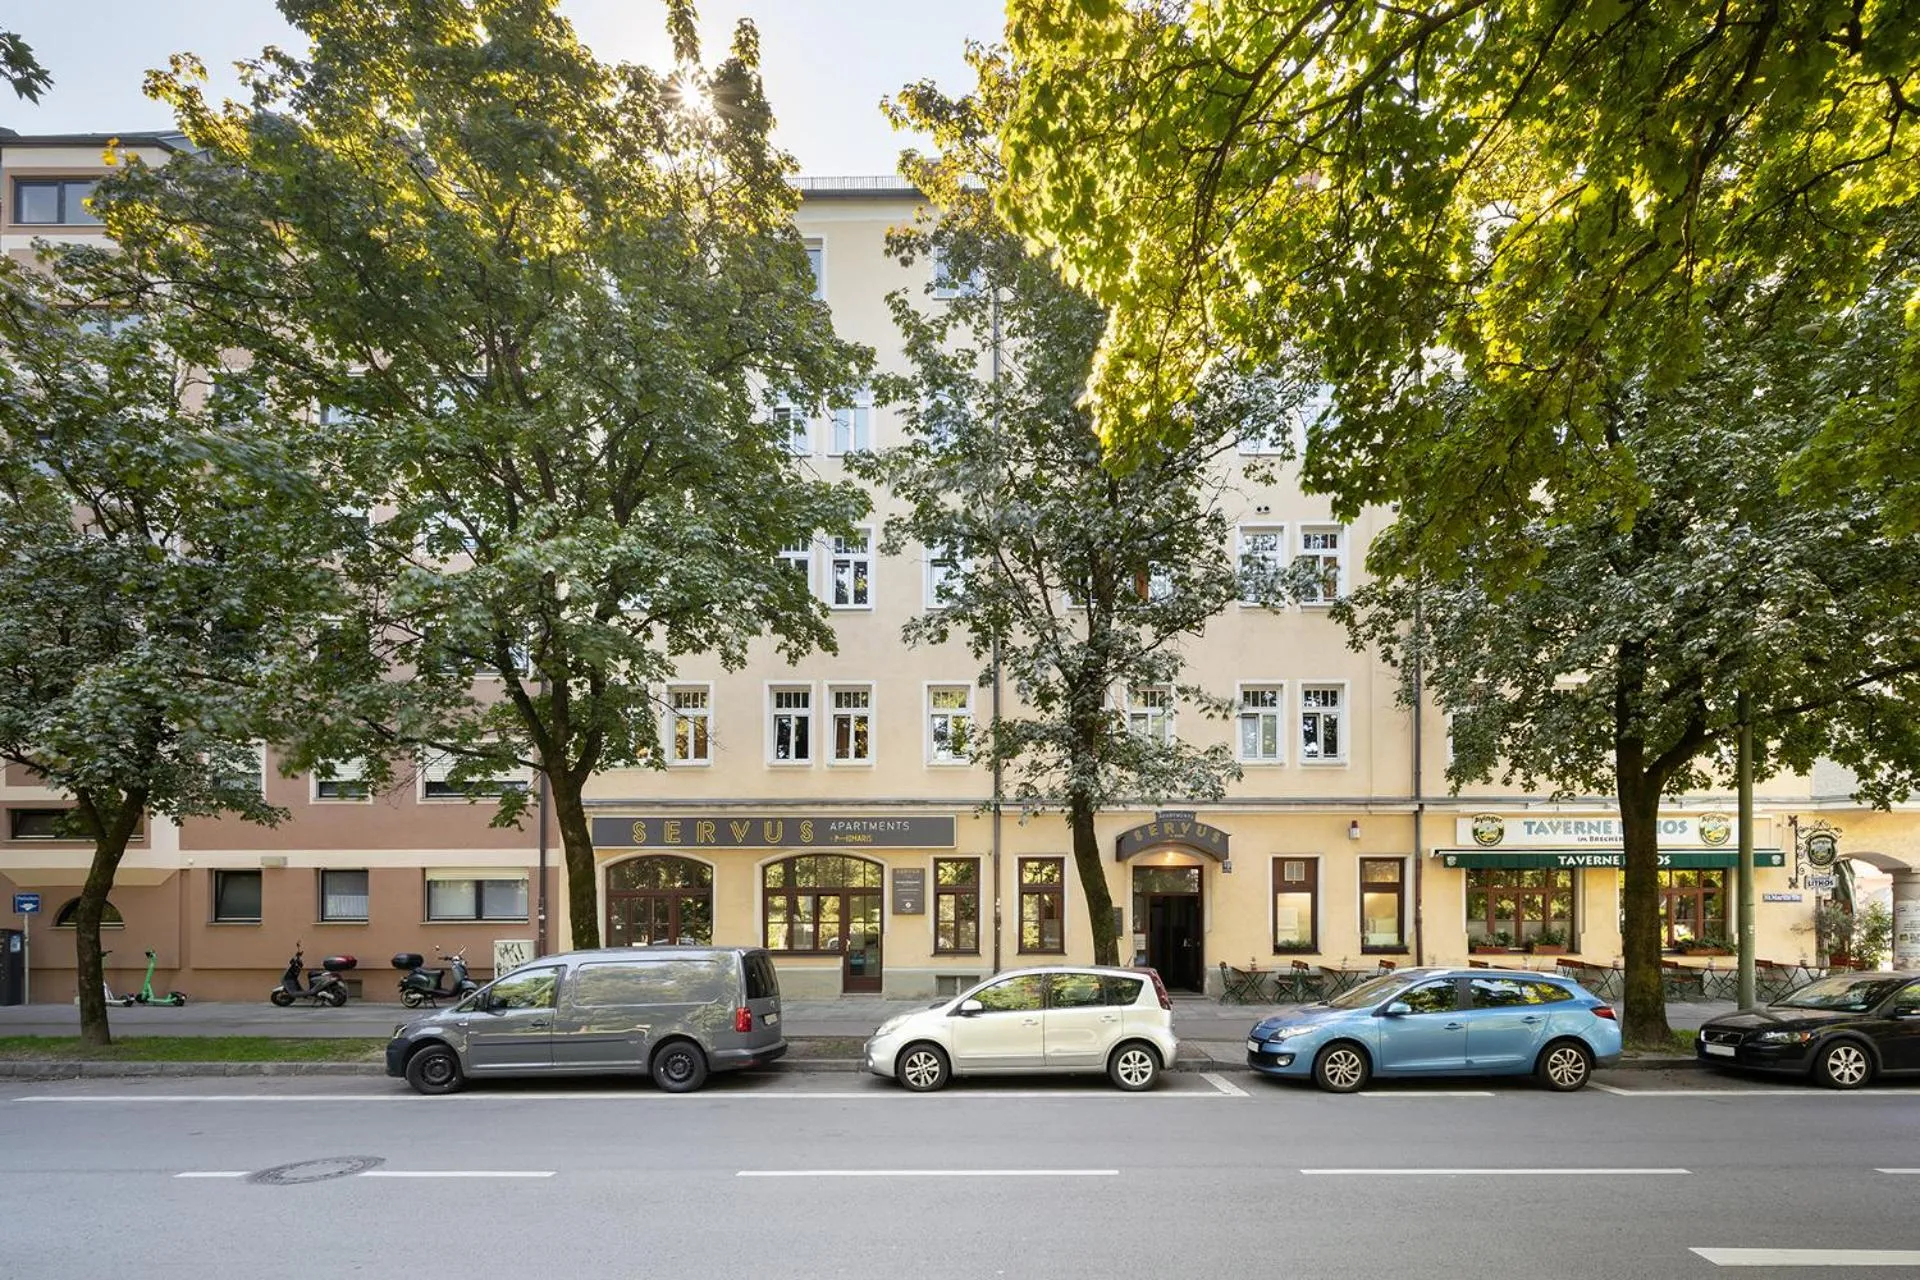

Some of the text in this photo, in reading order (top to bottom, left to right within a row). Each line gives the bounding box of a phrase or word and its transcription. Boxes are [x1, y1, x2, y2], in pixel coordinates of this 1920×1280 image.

[632, 820, 814, 844] SERVUS
[829, 821, 911, 832] APARTMENTS
[1134, 822, 1221, 843] SERVUS
[1523, 820, 1612, 835] TAVERNE
[1558, 855, 1620, 866] TAVERNE
